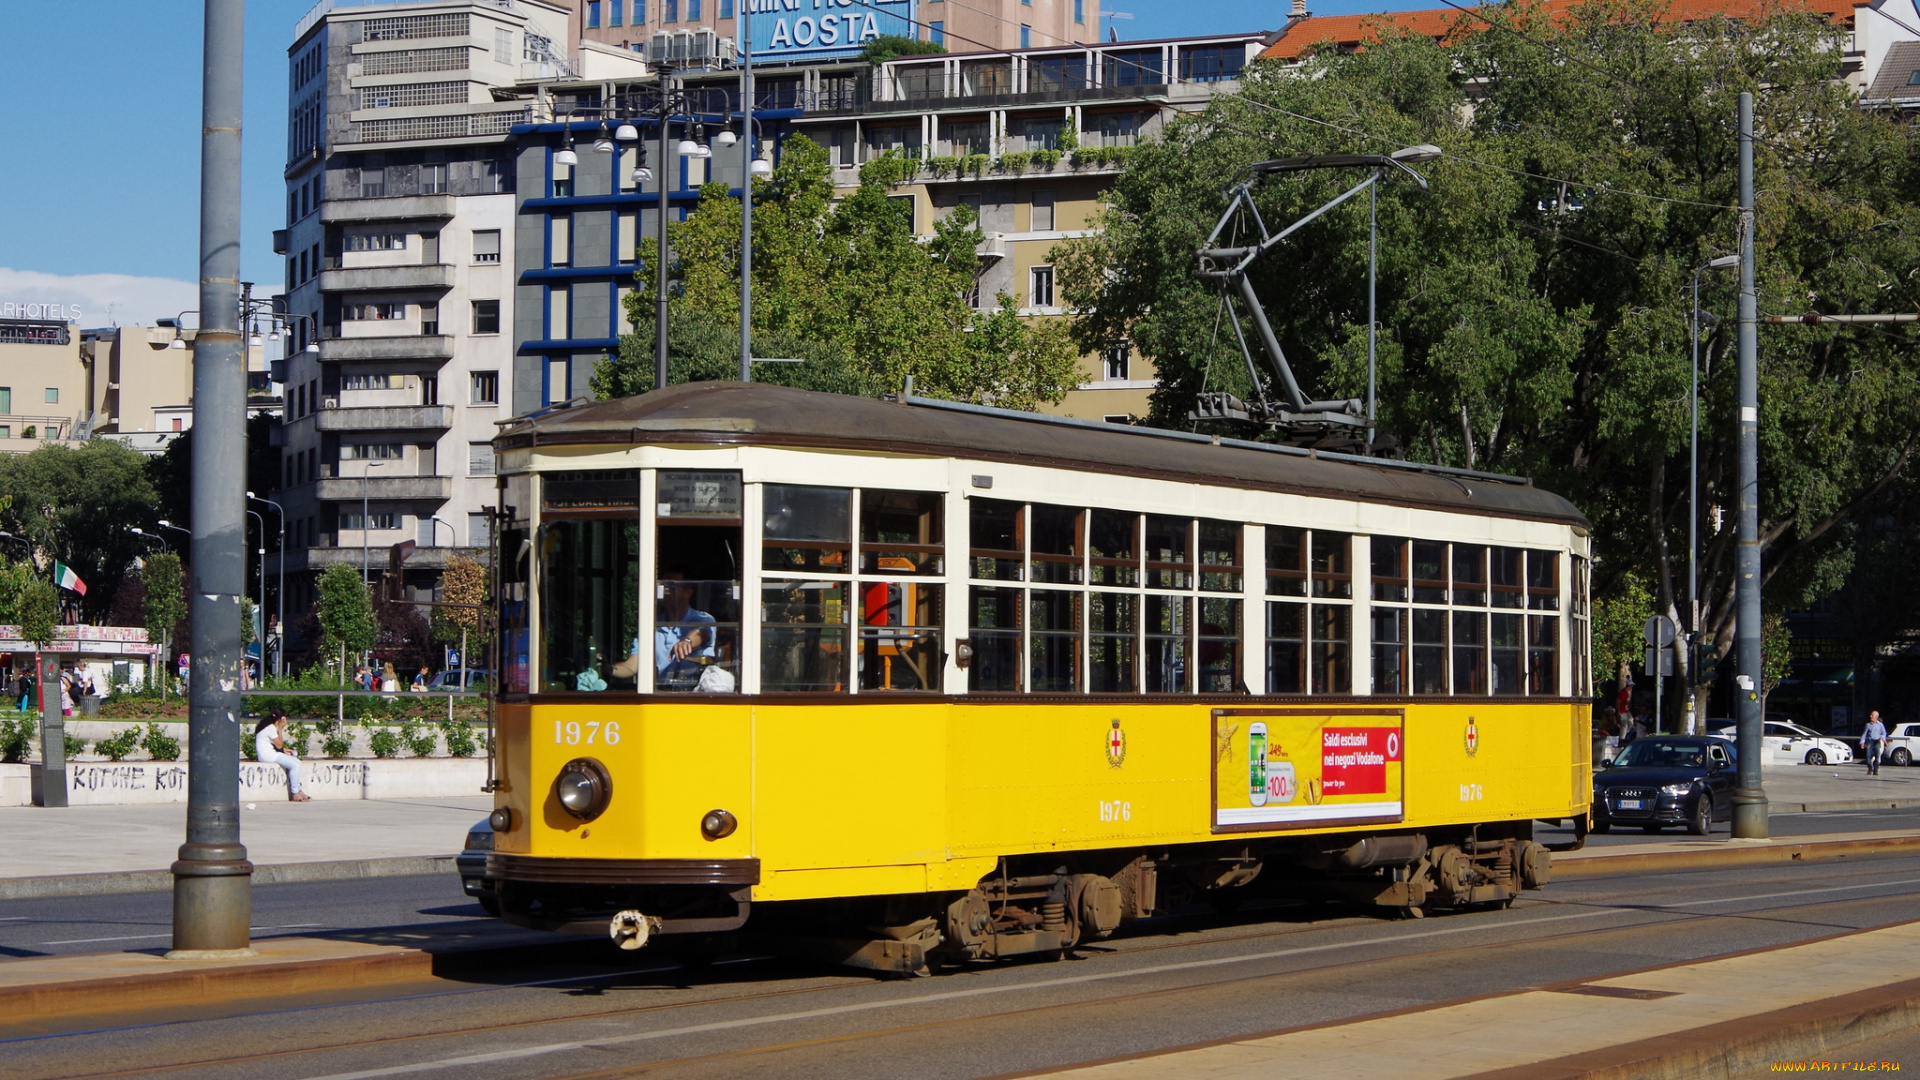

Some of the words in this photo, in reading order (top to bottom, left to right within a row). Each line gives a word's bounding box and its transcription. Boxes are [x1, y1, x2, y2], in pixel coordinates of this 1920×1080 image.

[770, 12, 881, 47] AOSTA
[0, 302, 82, 320] RHOTELS
[555, 720, 621, 746] 1976
[1324, 733, 1340, 747] Saldi
[1340, 733, 1368, 746] esclusivi
[1324, 753, 1334, 766] nei
[1335, 752, 1356, 769] negozi
[1356, 752, 1384, 765] Vodafone
[73, 765, 145, 791] KOTONE
[155, 767, 187, 790] KOT
[310, 762, 371, 787] KOTONE
[1460, 783, 1482, 802] 1976
[1099, 800, 1131, 822] 1976
